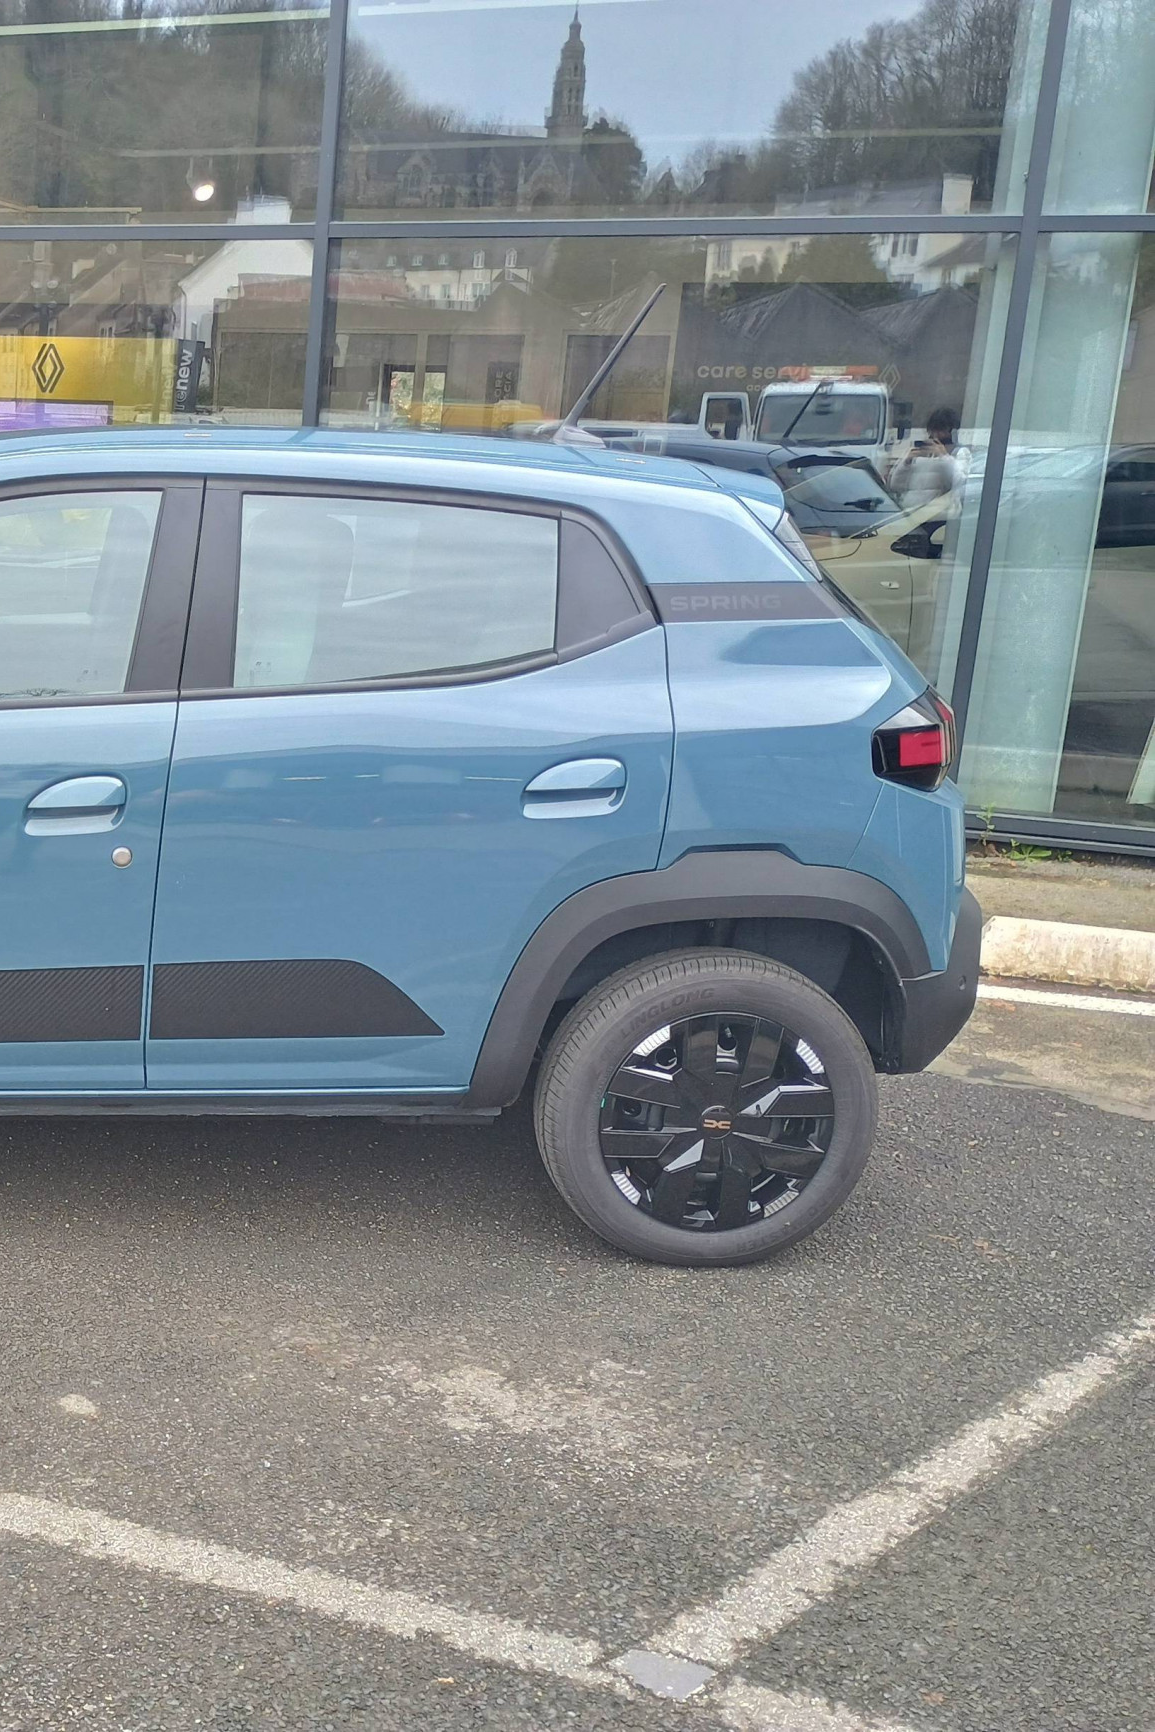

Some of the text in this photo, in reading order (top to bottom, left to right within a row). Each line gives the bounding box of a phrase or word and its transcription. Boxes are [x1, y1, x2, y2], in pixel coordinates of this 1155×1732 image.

[174, 349, 193, 411] renew
[494, 371, 504, 398] ORE
[697, 365, 747, 379] care
[670, 594, 782, 612] SPRING
[620, 987, 715, 1038] LINGLONG
